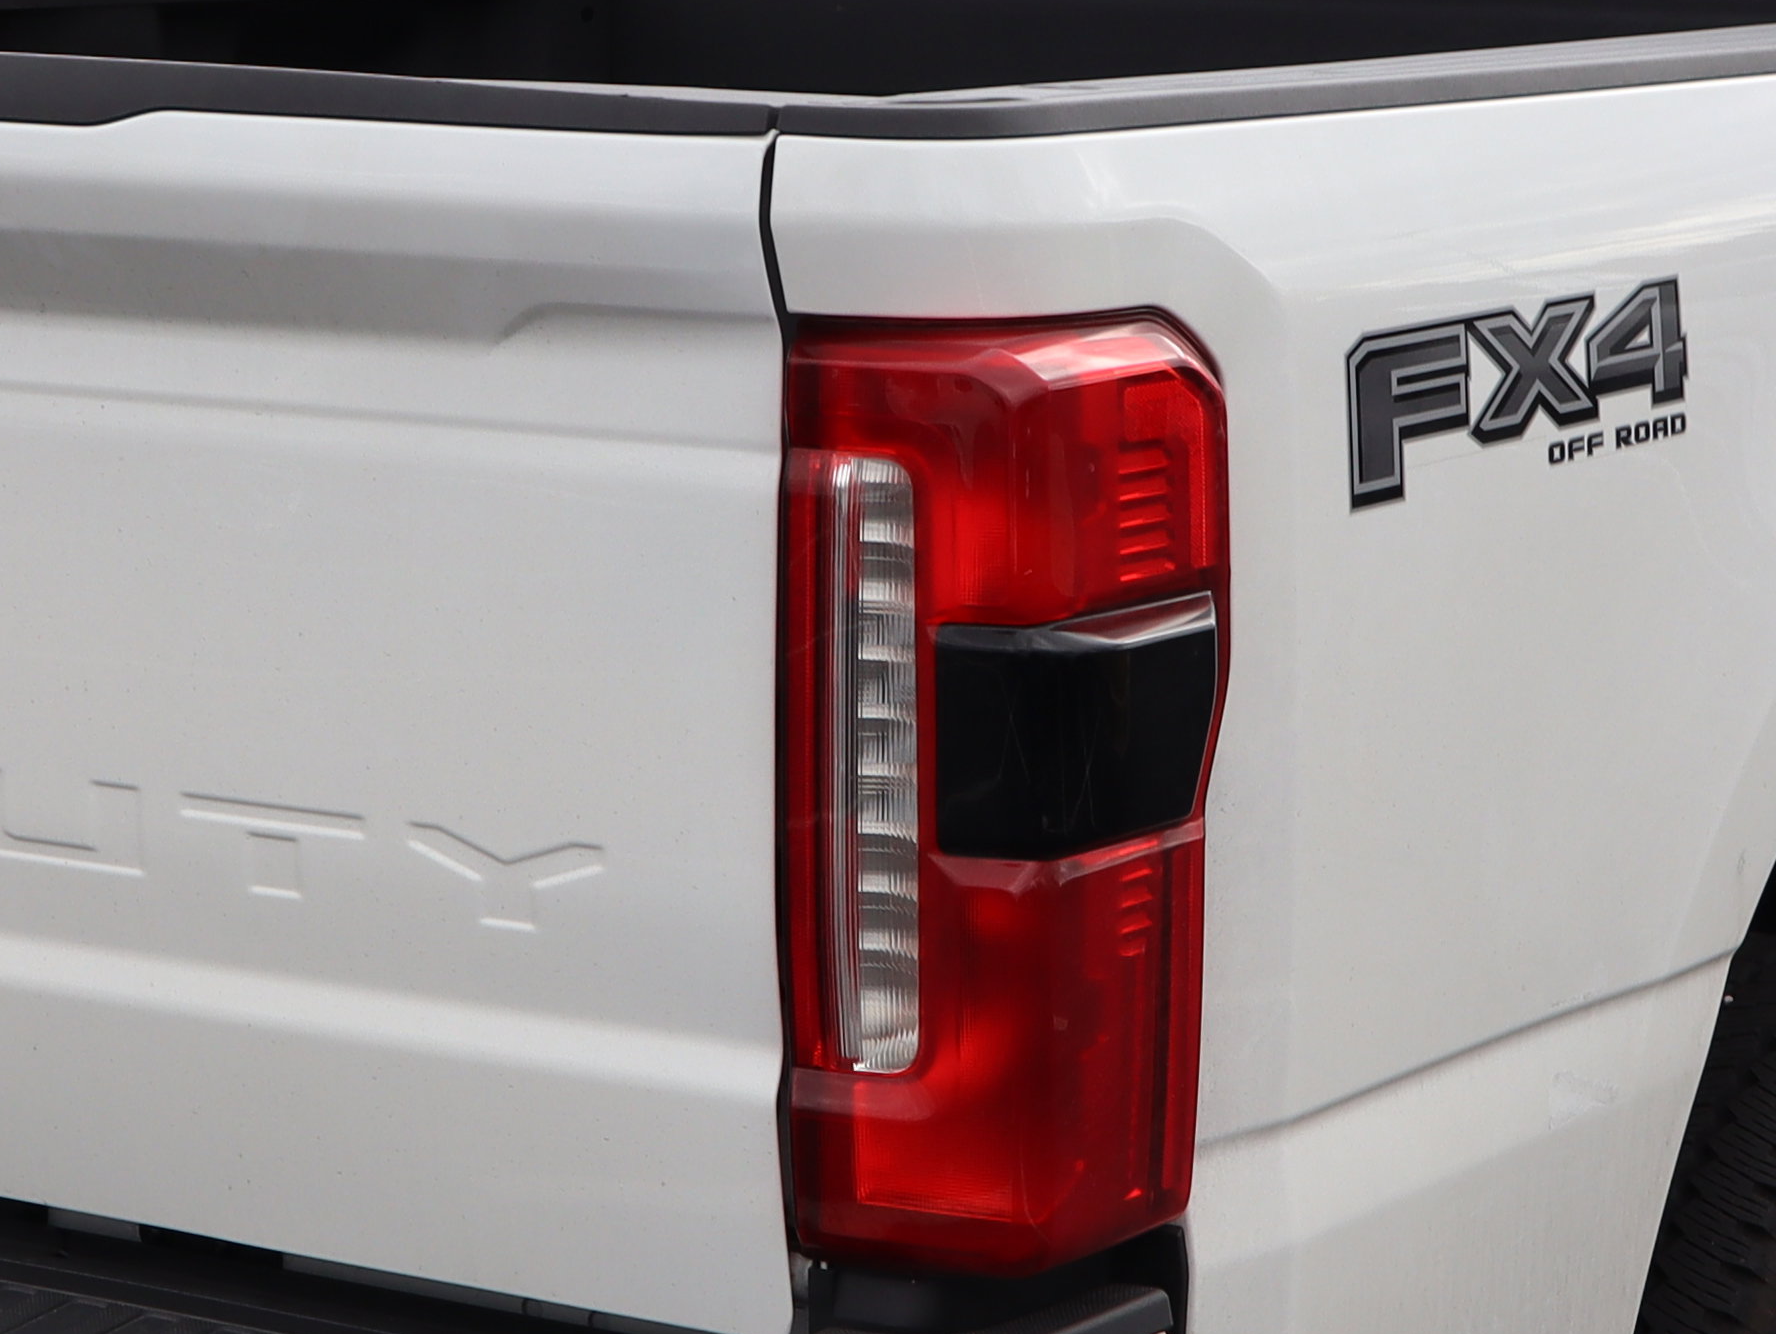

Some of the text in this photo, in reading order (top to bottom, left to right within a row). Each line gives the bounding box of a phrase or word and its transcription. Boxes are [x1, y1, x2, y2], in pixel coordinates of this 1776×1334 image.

[1345, 274, 1688, 514] FX4
[1548, 413, 1688, 466] OFF ROAD
